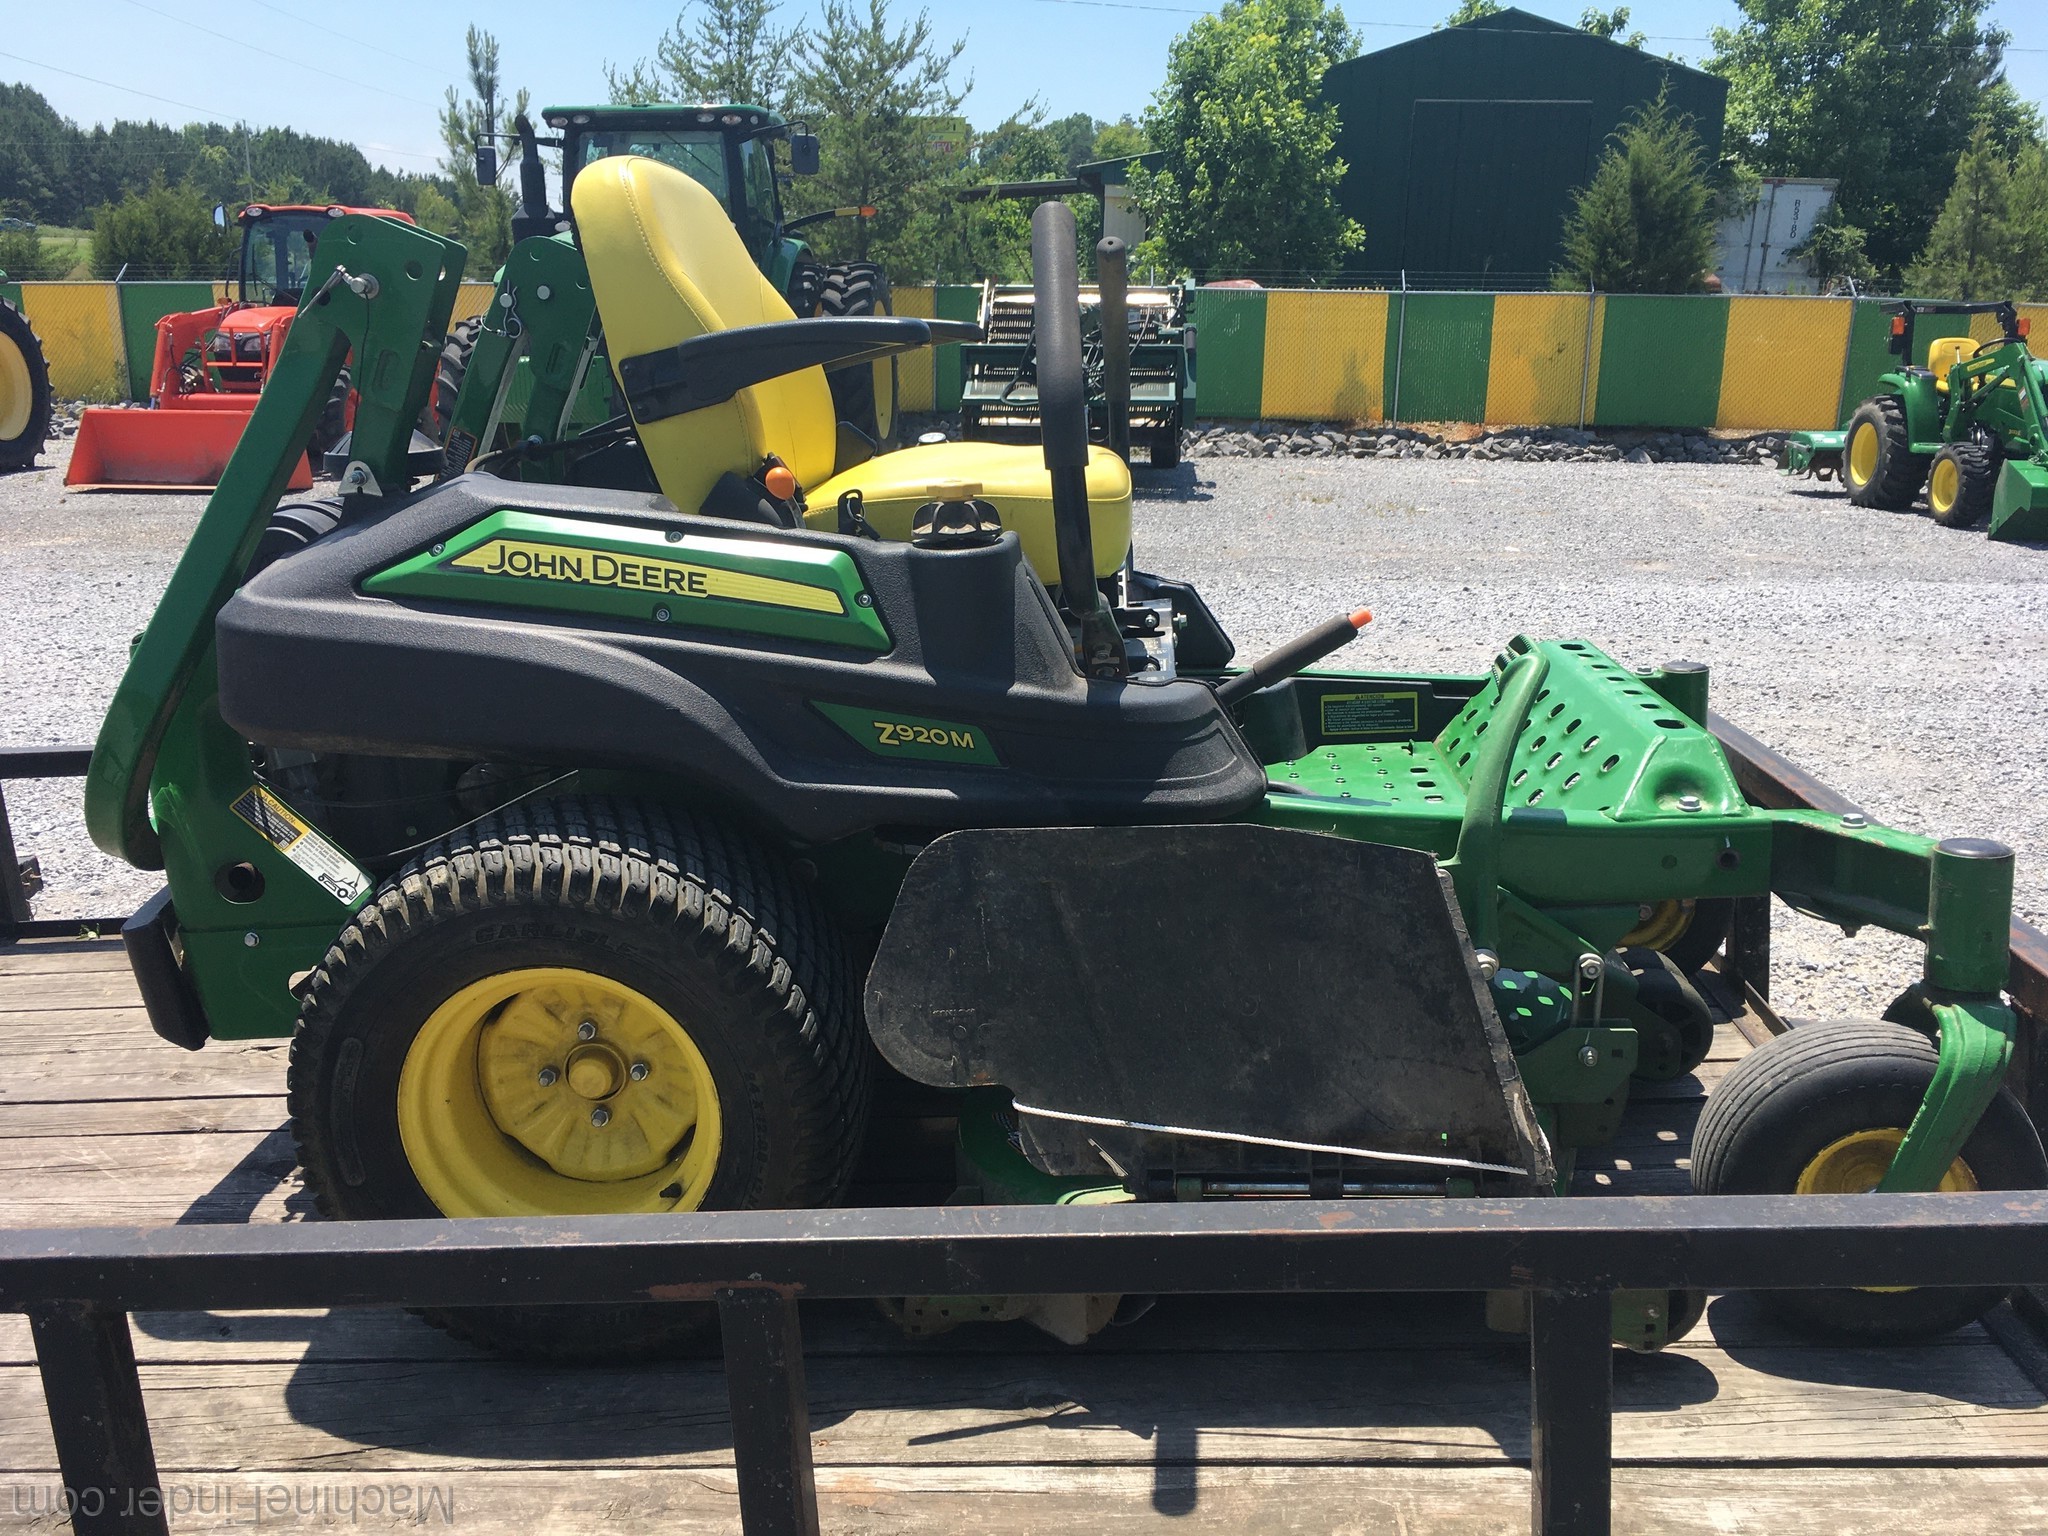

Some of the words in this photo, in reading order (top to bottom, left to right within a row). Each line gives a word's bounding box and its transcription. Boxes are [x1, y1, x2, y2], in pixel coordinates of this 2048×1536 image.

[485, 542, 584, 579] JOHN
[592, 554, 708, 595] DEERE
[873, 721, 975, 750] Z920M
[267, 798, 295, 823] CAUTION
